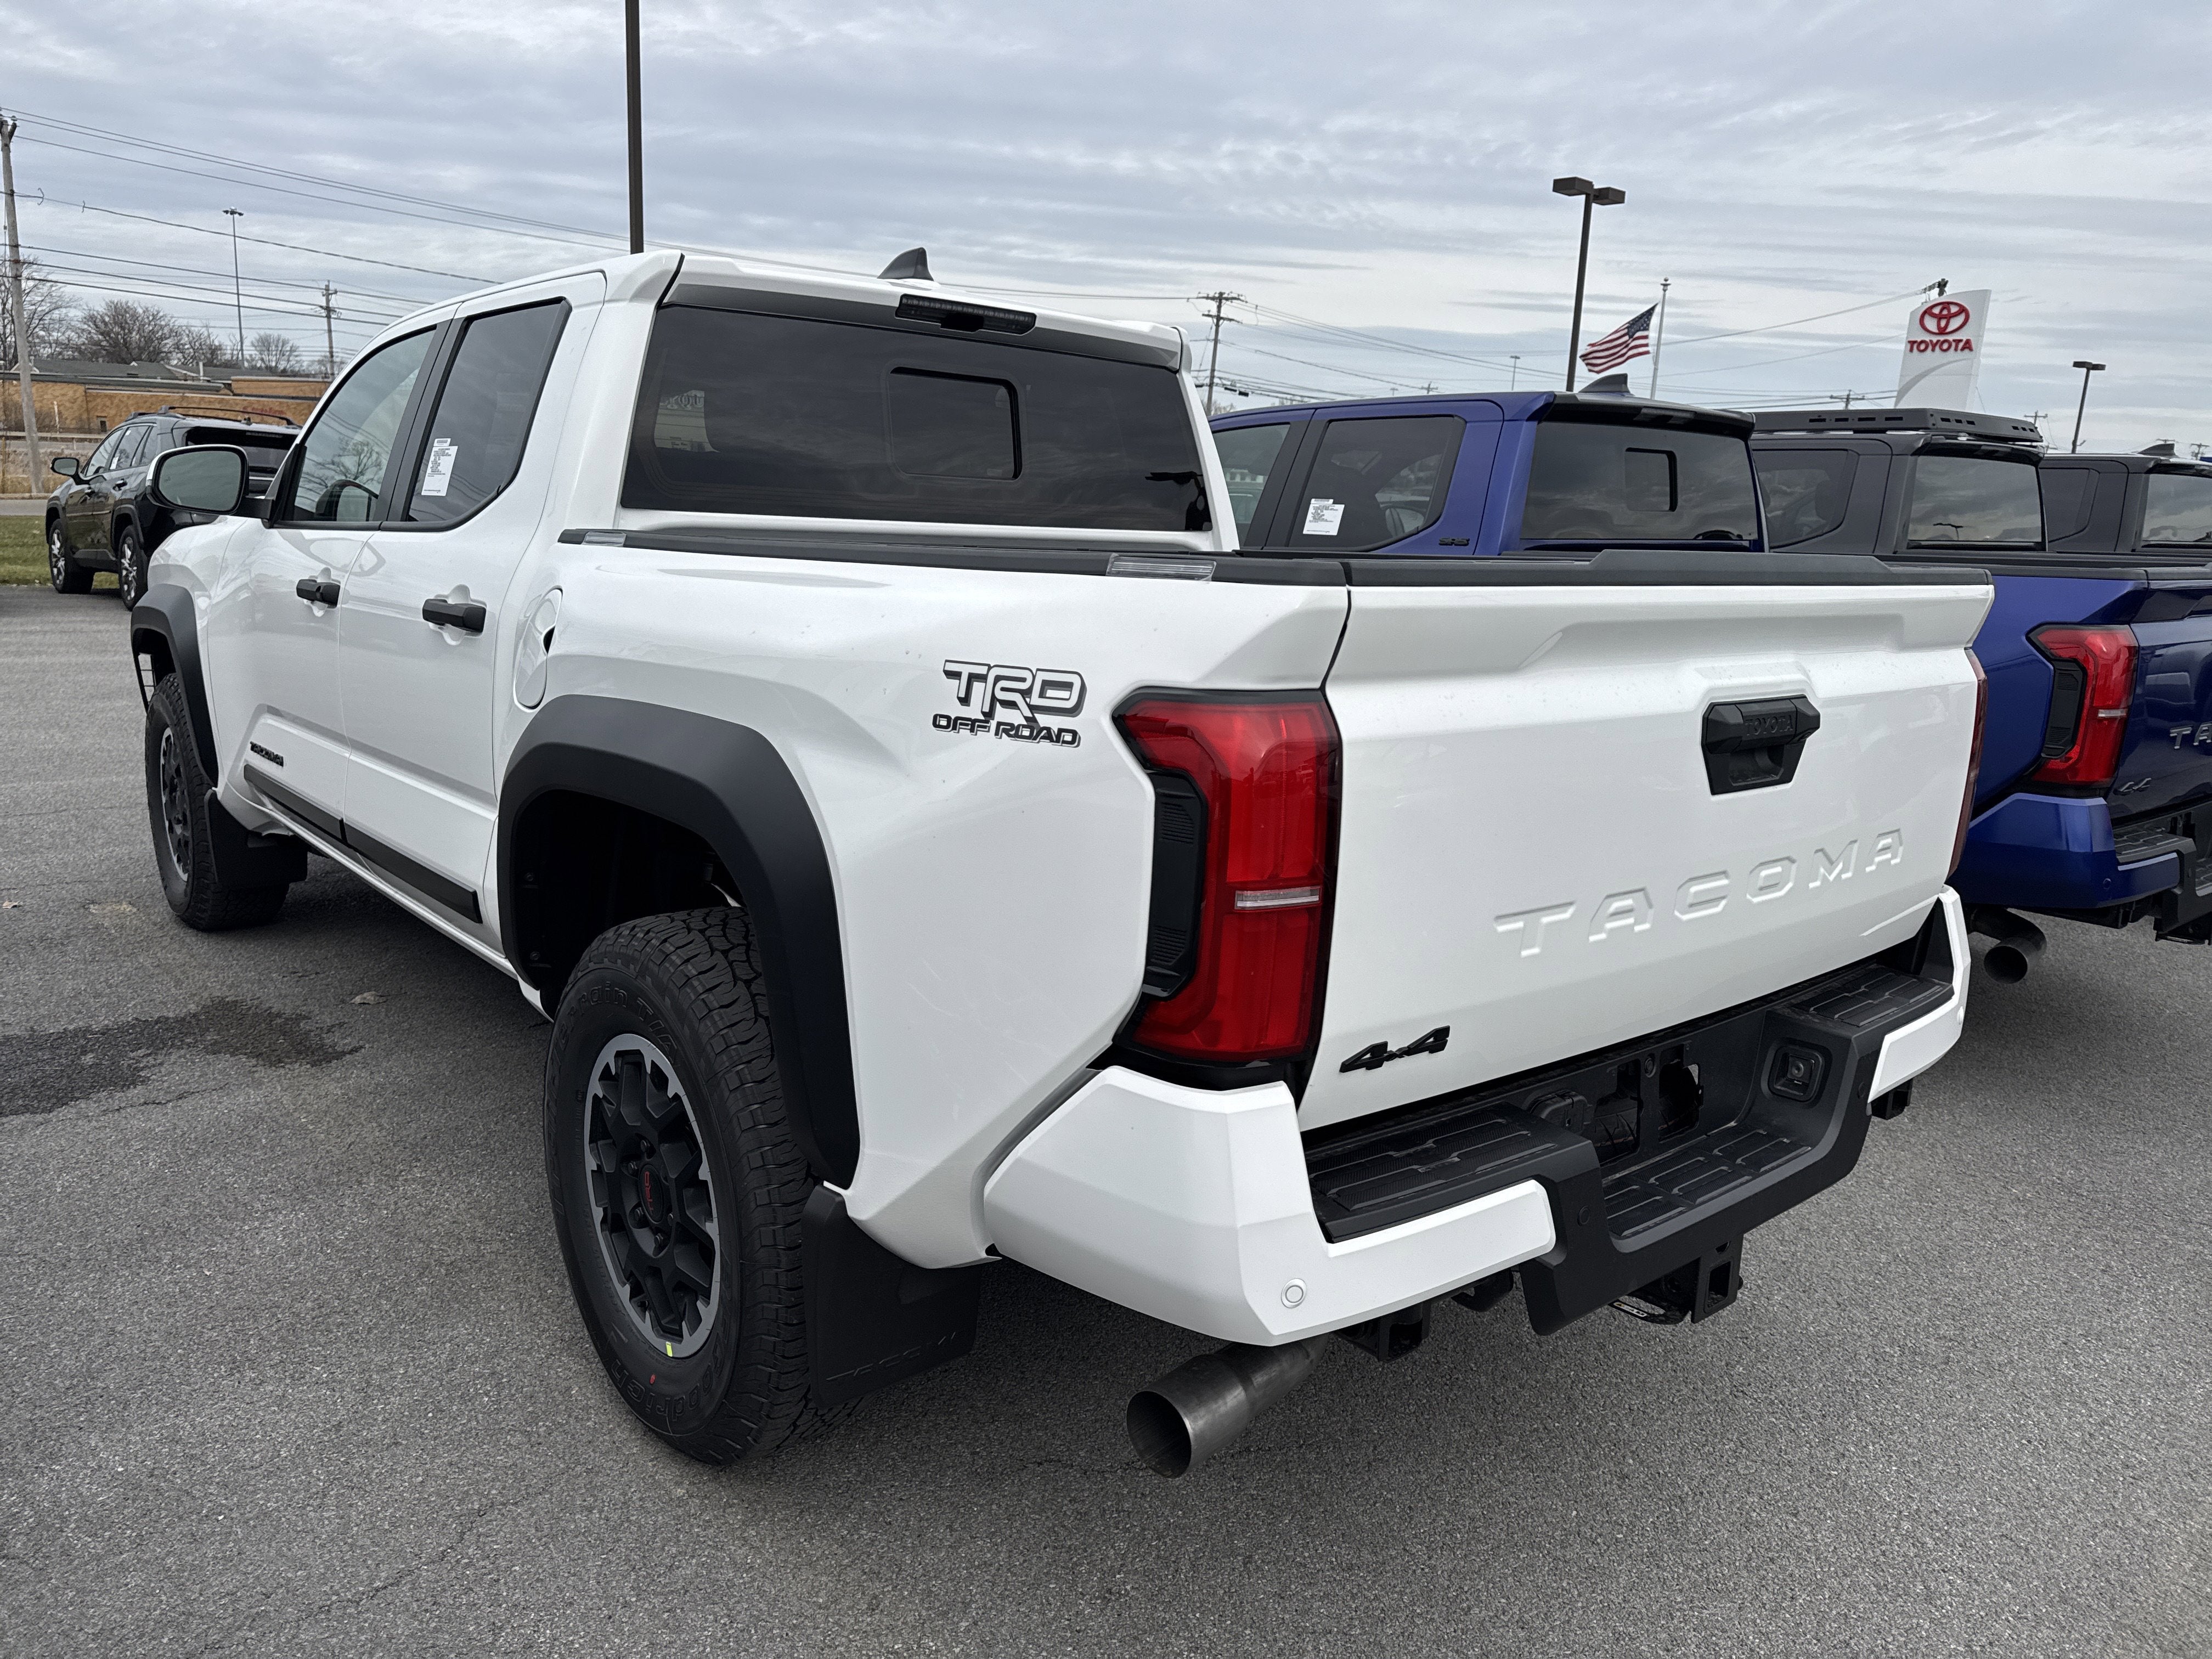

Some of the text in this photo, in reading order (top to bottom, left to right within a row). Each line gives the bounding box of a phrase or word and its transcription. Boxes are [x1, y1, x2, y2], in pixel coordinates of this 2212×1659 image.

[1908, 338, 1973, 353] TOYOTA
[943, 659, 1087, 727] TRD
[932, 713, 1081, 748] OFF ROAD
[1745, 714, 1793, 736] TOYOTA
[250, 741, 284, 768] TACOMA
[1494, 828, 1904, 957] TACOMA
[645, 1171, 654, 1216] TRD
